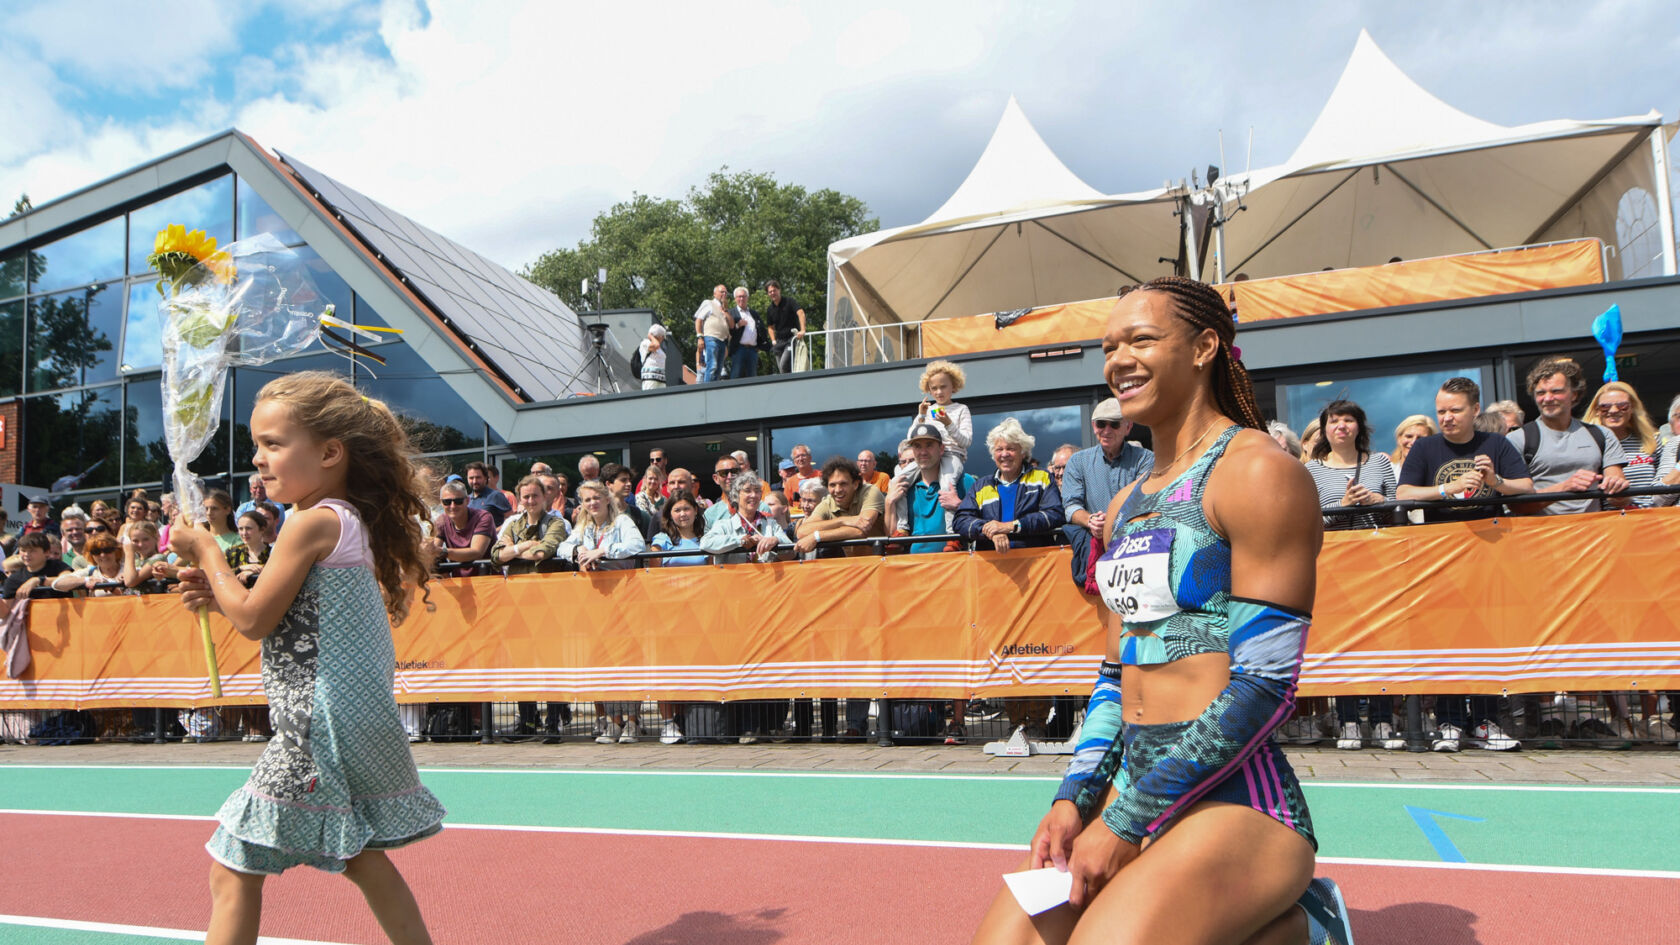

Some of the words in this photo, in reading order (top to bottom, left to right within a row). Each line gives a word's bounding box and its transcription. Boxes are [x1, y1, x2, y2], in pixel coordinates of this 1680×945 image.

[1108, 564, 1144, 592] Jiya
[1114, 596, 1138, 615] 519
[1001, 643, 1074, 656] Atletiekunie
